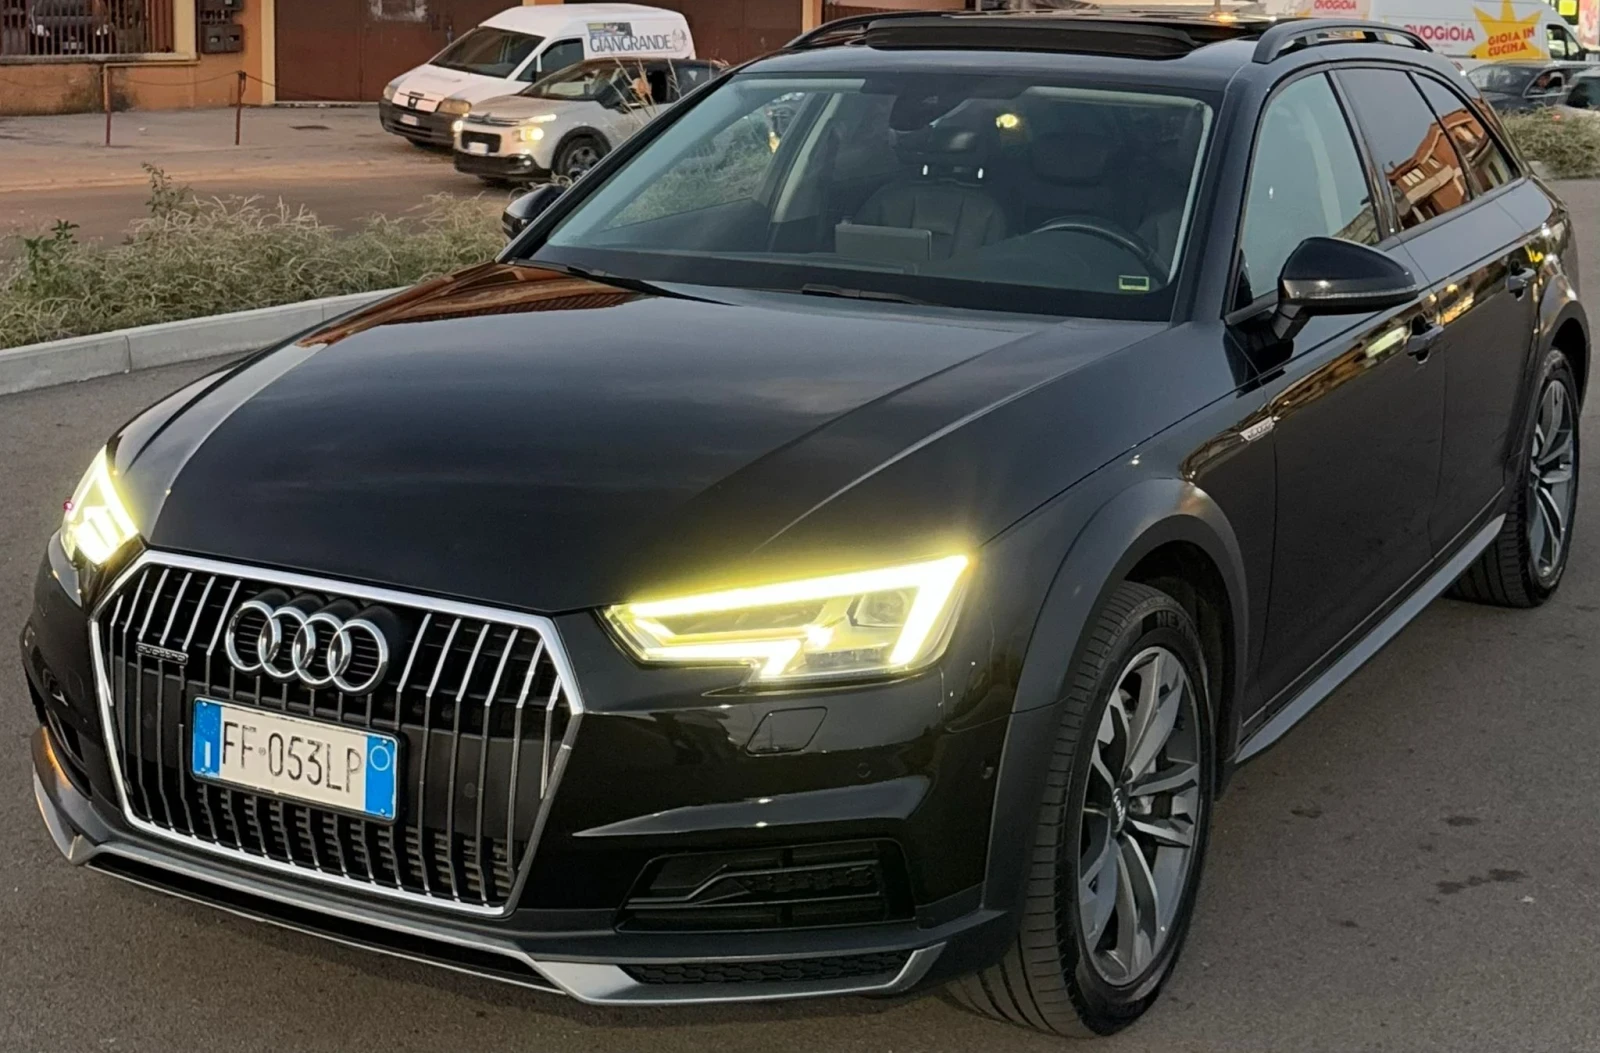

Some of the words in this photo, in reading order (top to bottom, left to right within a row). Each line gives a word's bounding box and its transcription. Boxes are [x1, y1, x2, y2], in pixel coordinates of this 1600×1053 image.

[590, 34, 673, 52] GIANGRANDE
[1488, 31, 1520, 46] GIOIA
[1522, 26, 1535, 39] IN
[1488, 41, 1528, 56] CUCINA
